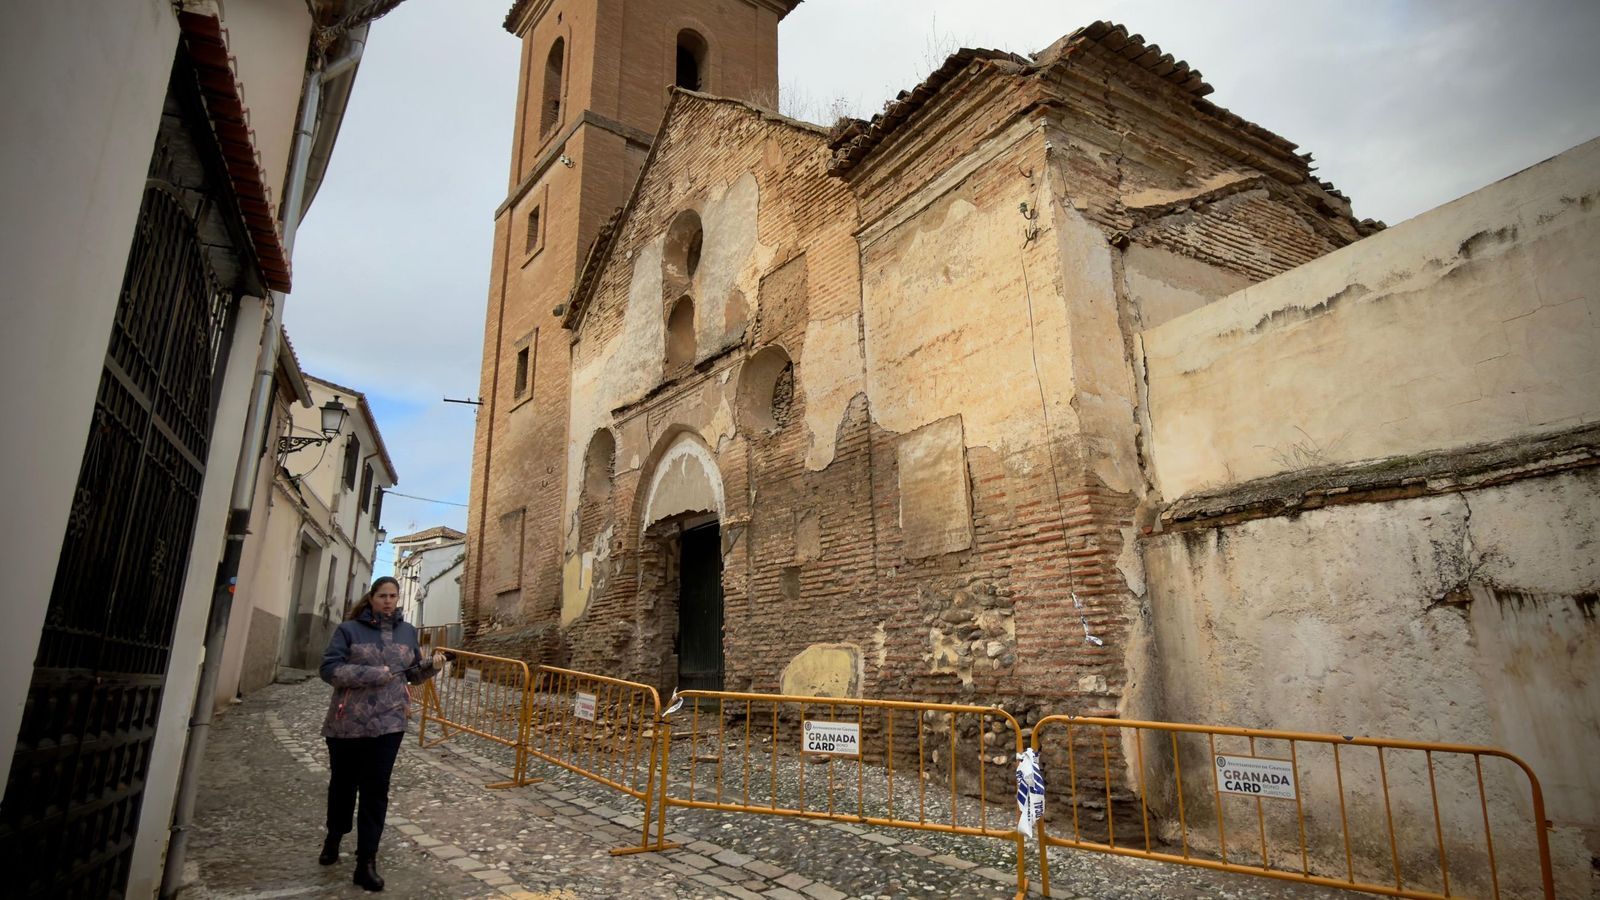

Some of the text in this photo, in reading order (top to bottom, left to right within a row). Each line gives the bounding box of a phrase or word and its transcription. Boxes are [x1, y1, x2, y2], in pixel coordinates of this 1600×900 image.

[808, 732, 856, 743] GRANADA
[808, 742, 835, 751] CARD
[1223, 769, 1290, 786] GRANADA
[1225, 780, 1261, 793] CARD
